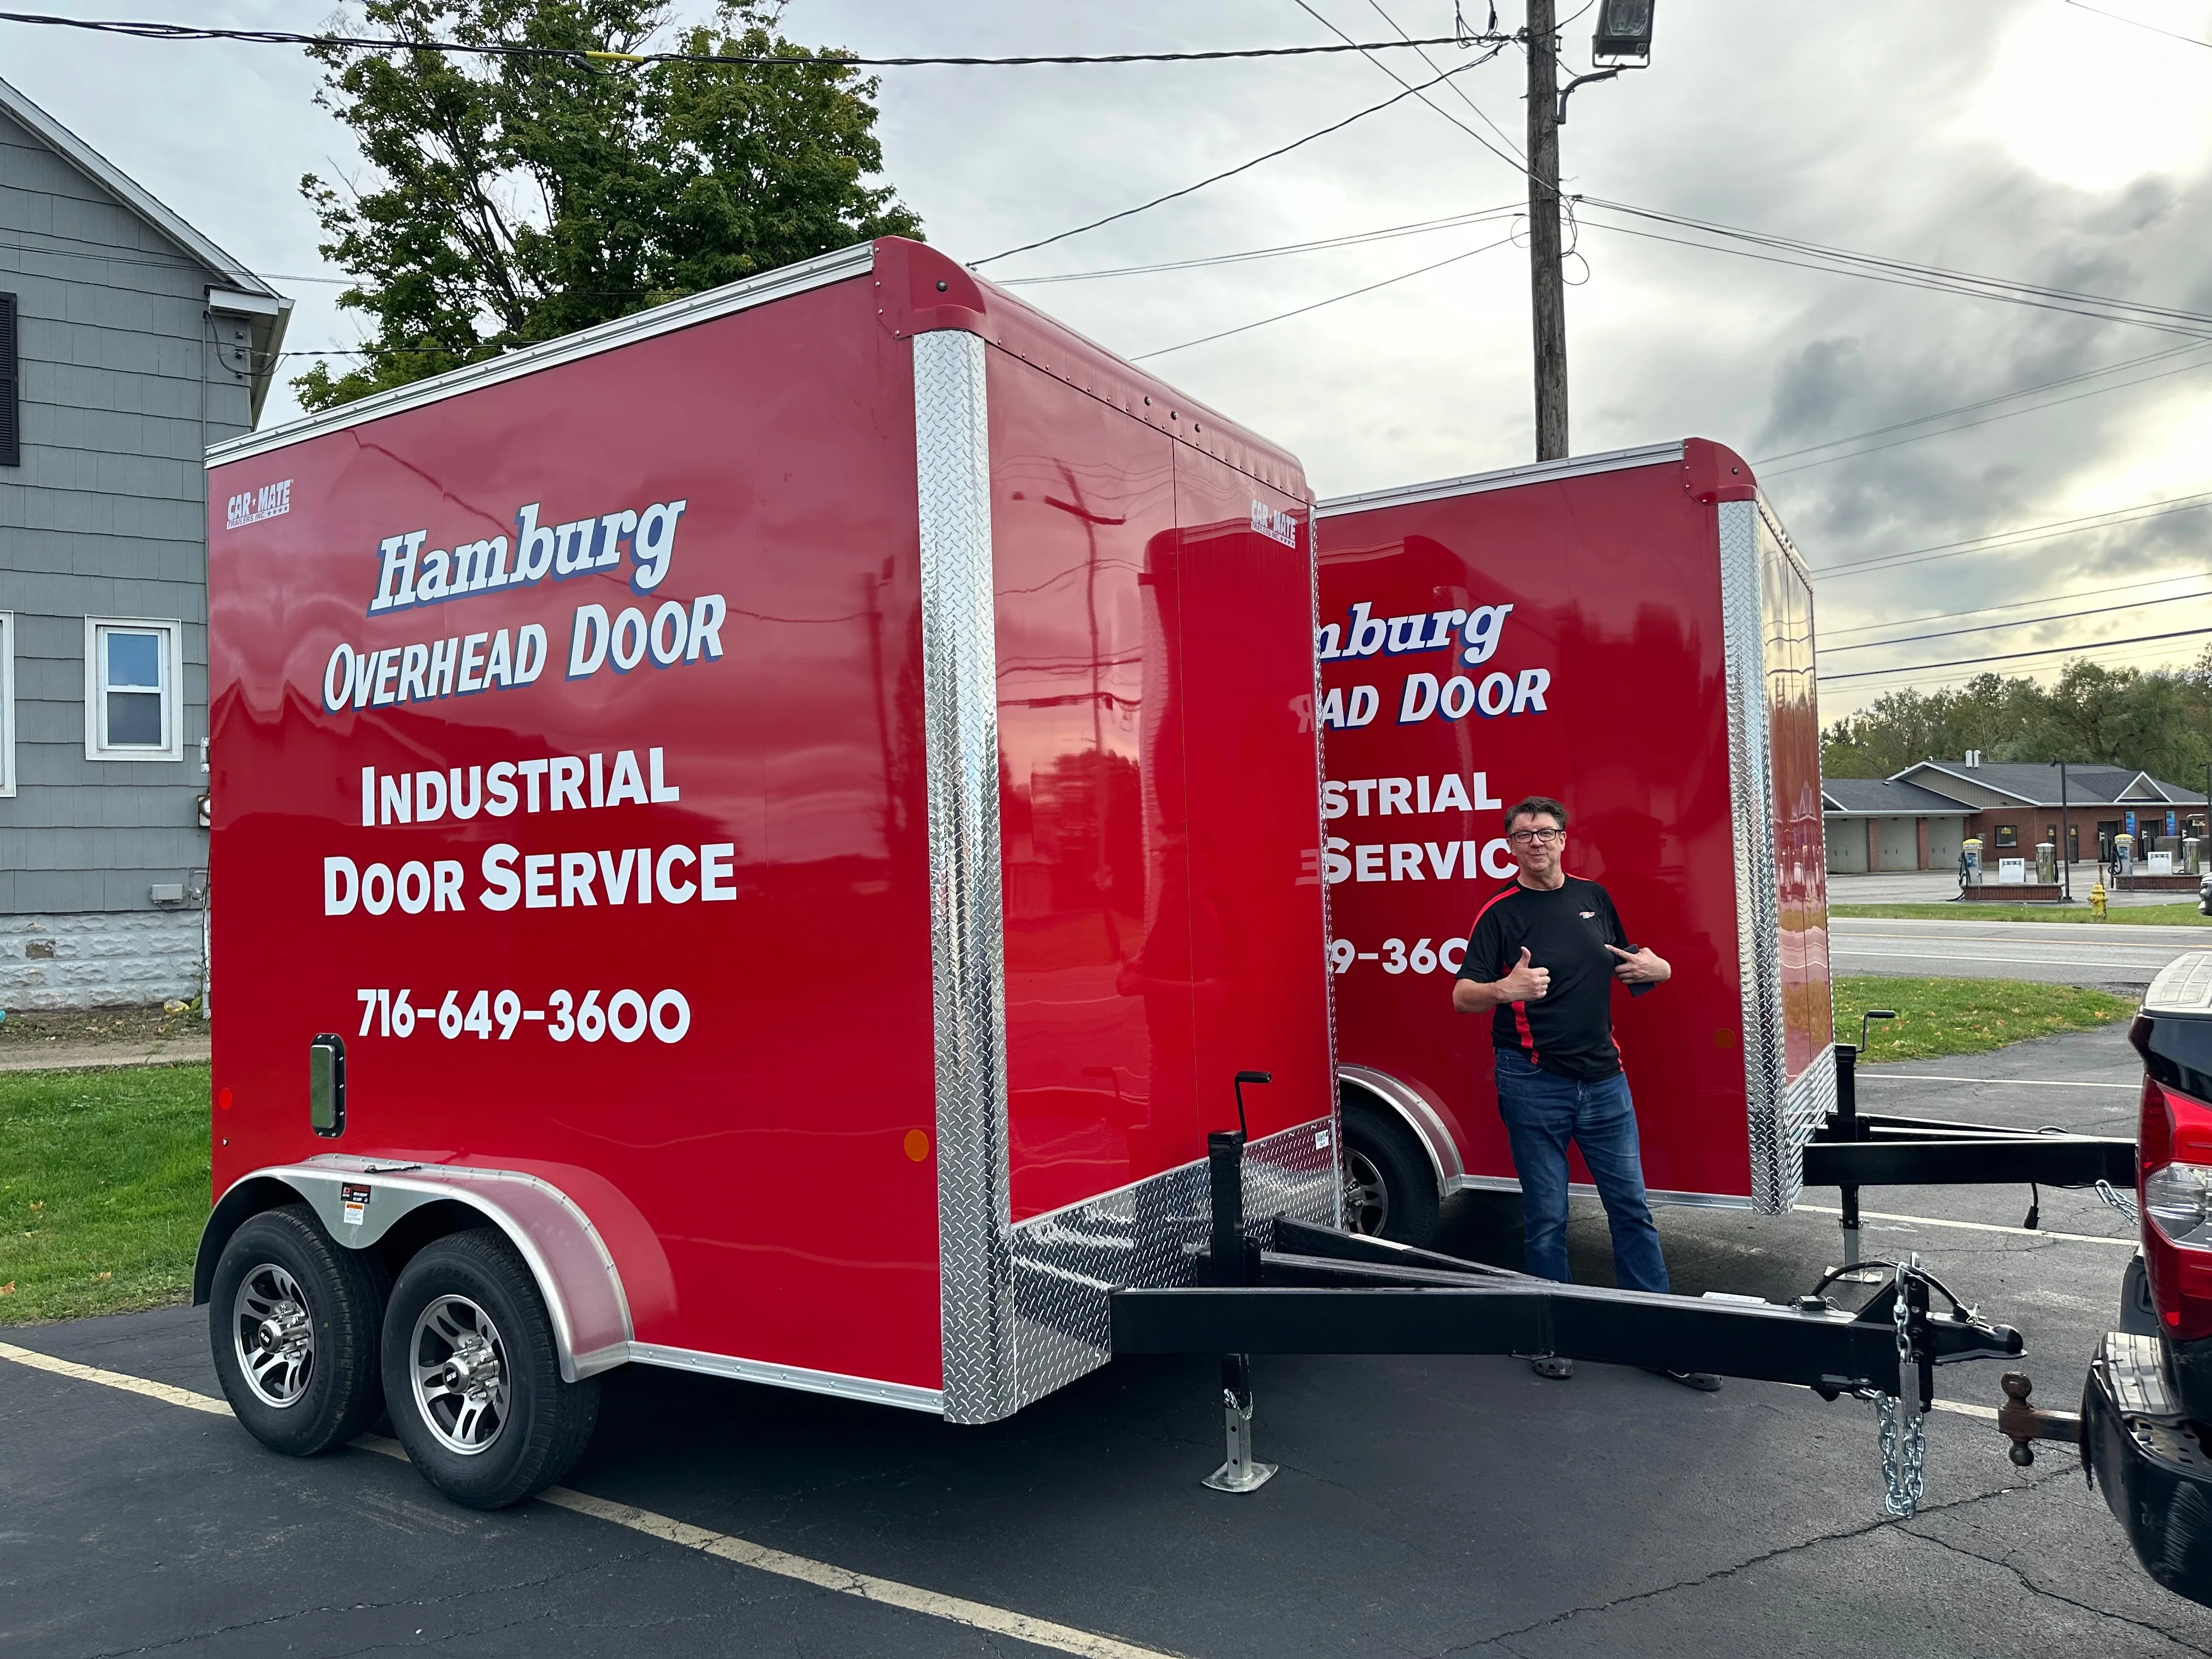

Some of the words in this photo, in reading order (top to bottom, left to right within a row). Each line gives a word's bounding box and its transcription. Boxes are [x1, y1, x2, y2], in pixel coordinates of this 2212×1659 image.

[228, 492, 251, 521] CAR
[257, 479, 290, 512] MATE
[228, 516, 253, 528] TRAILERS
[255, 511, 266, 521] INC.
[1251, 499, 1268, 527] CAR
[1273, 509, 1296, 540] MATE
[369, 499, 686, 611] Hamburg
[1251, 522, 1271, 537] TRAILERS
[324, 623, 548, 712] OVERHEAD
[568, 593, 726, 677] DOOR
[1400, 668, 1550, 723] DOOR
[362, 747, 680, 827] INDUSTRIAL
[324, 856, 465, 916] DOOR
[479, 842, 737, 911] SERVICE
[357, 989, 691, 1044] 716-649-3600
